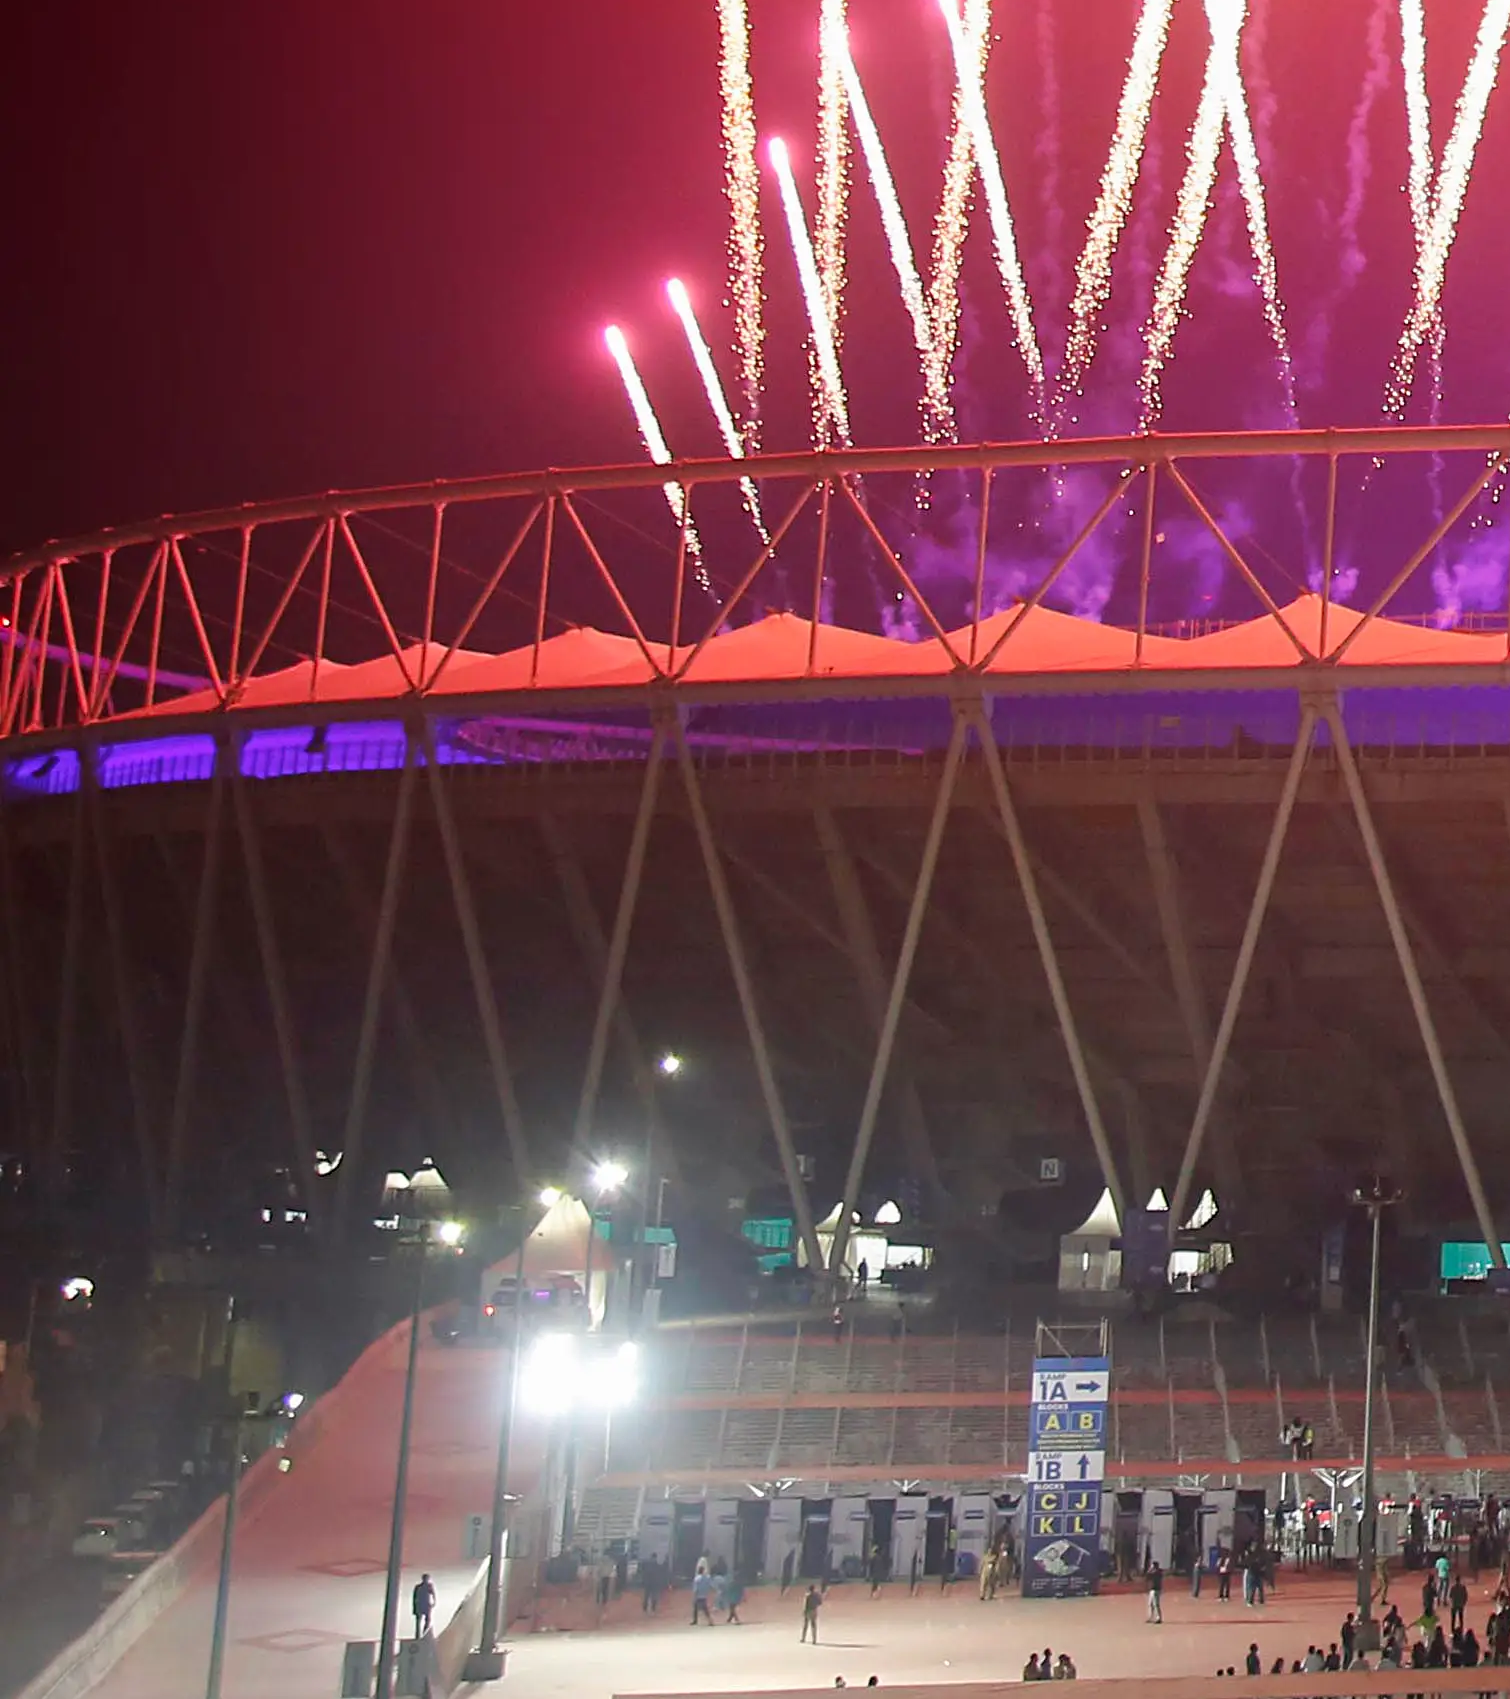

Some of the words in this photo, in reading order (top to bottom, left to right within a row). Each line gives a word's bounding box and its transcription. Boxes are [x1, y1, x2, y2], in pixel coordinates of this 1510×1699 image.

[1039, 1381, 1068, 1401] 1A
[1045, 1412, 1061, 1431] A
[1080, 1412, 1094, 1430] B
[1036, 1461, 1062, 1480] 1B
[1041, 1493, 1057, 1510] C
[1075, 1492, 1088, 1510] J
[1039, 1516, 1054, 1534] K
[1074, 1516, 1085, 1533] L
